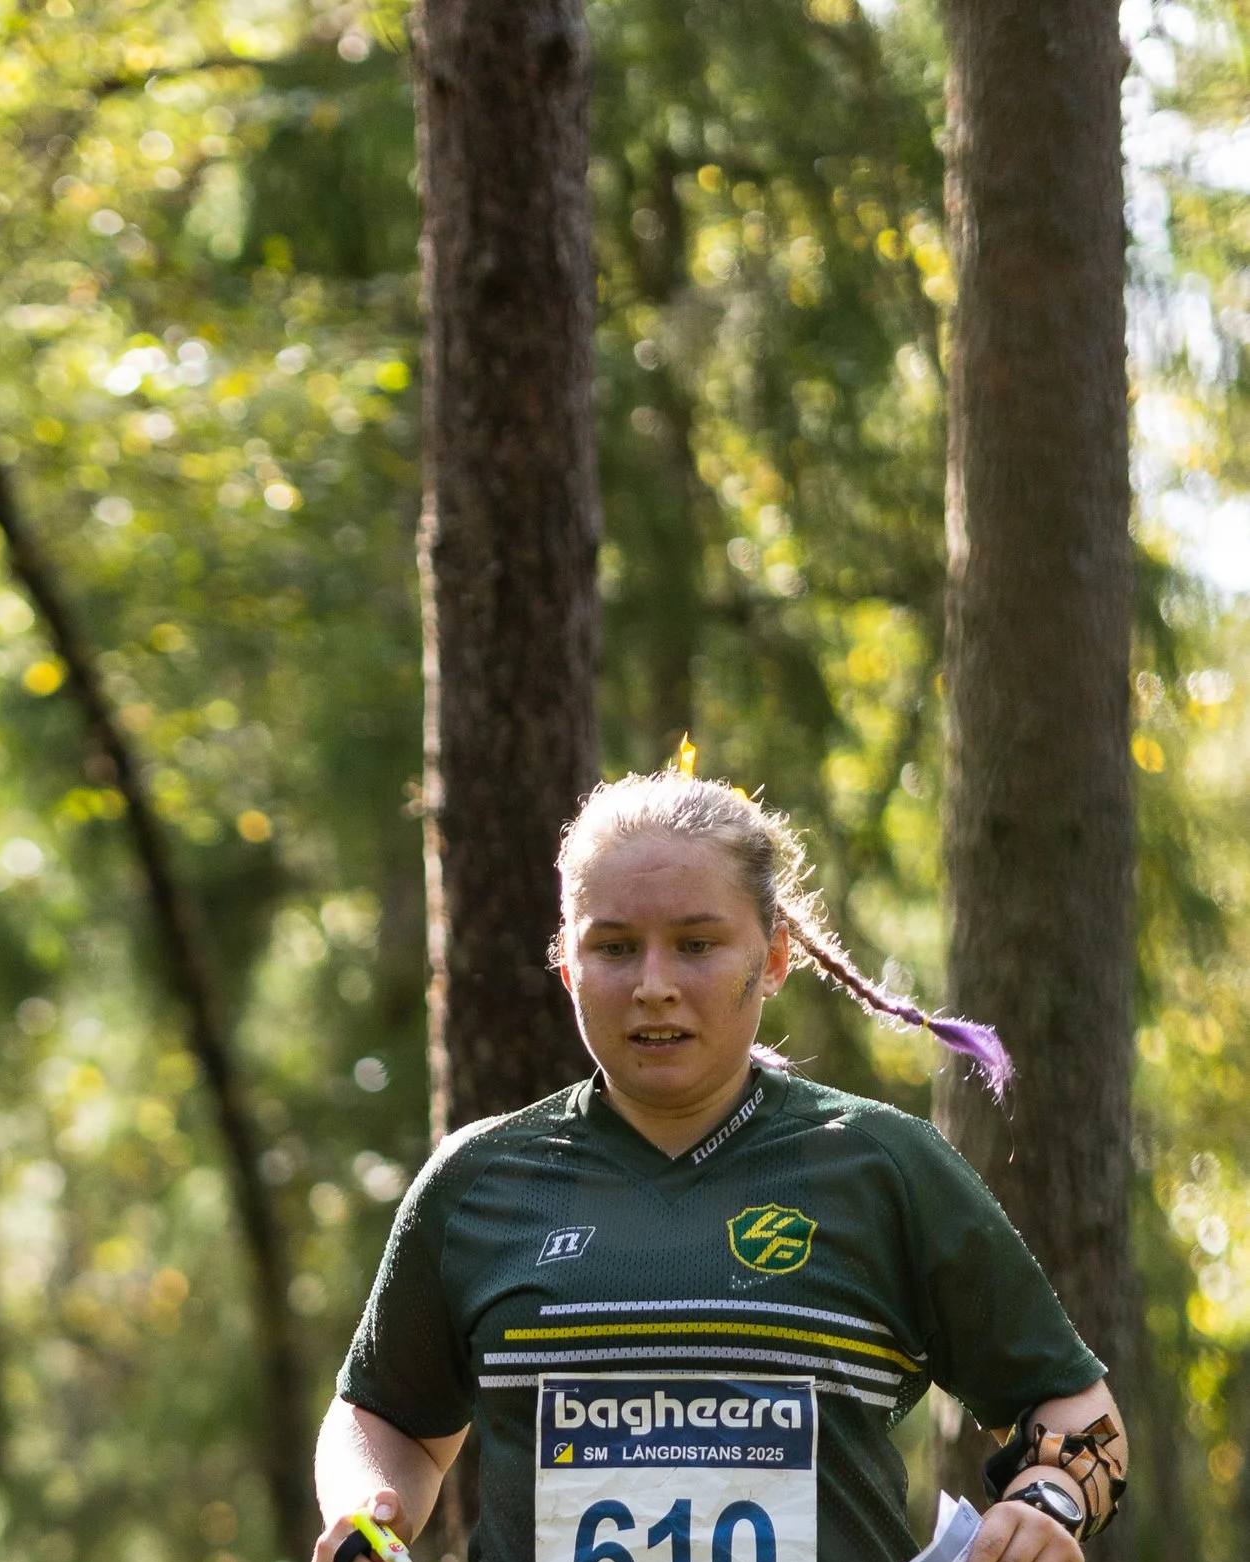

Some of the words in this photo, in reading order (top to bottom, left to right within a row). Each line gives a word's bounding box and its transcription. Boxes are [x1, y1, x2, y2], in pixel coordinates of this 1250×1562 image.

[691, 1087, 764, 1164] noname
[555, 1390, 801, 1435] bagheera
[583, 1446, 608, 1461] SM
[622, 1444, 742, 1461] LÅNGDISTANS
[746, 1446, 784, 1461] 2025
